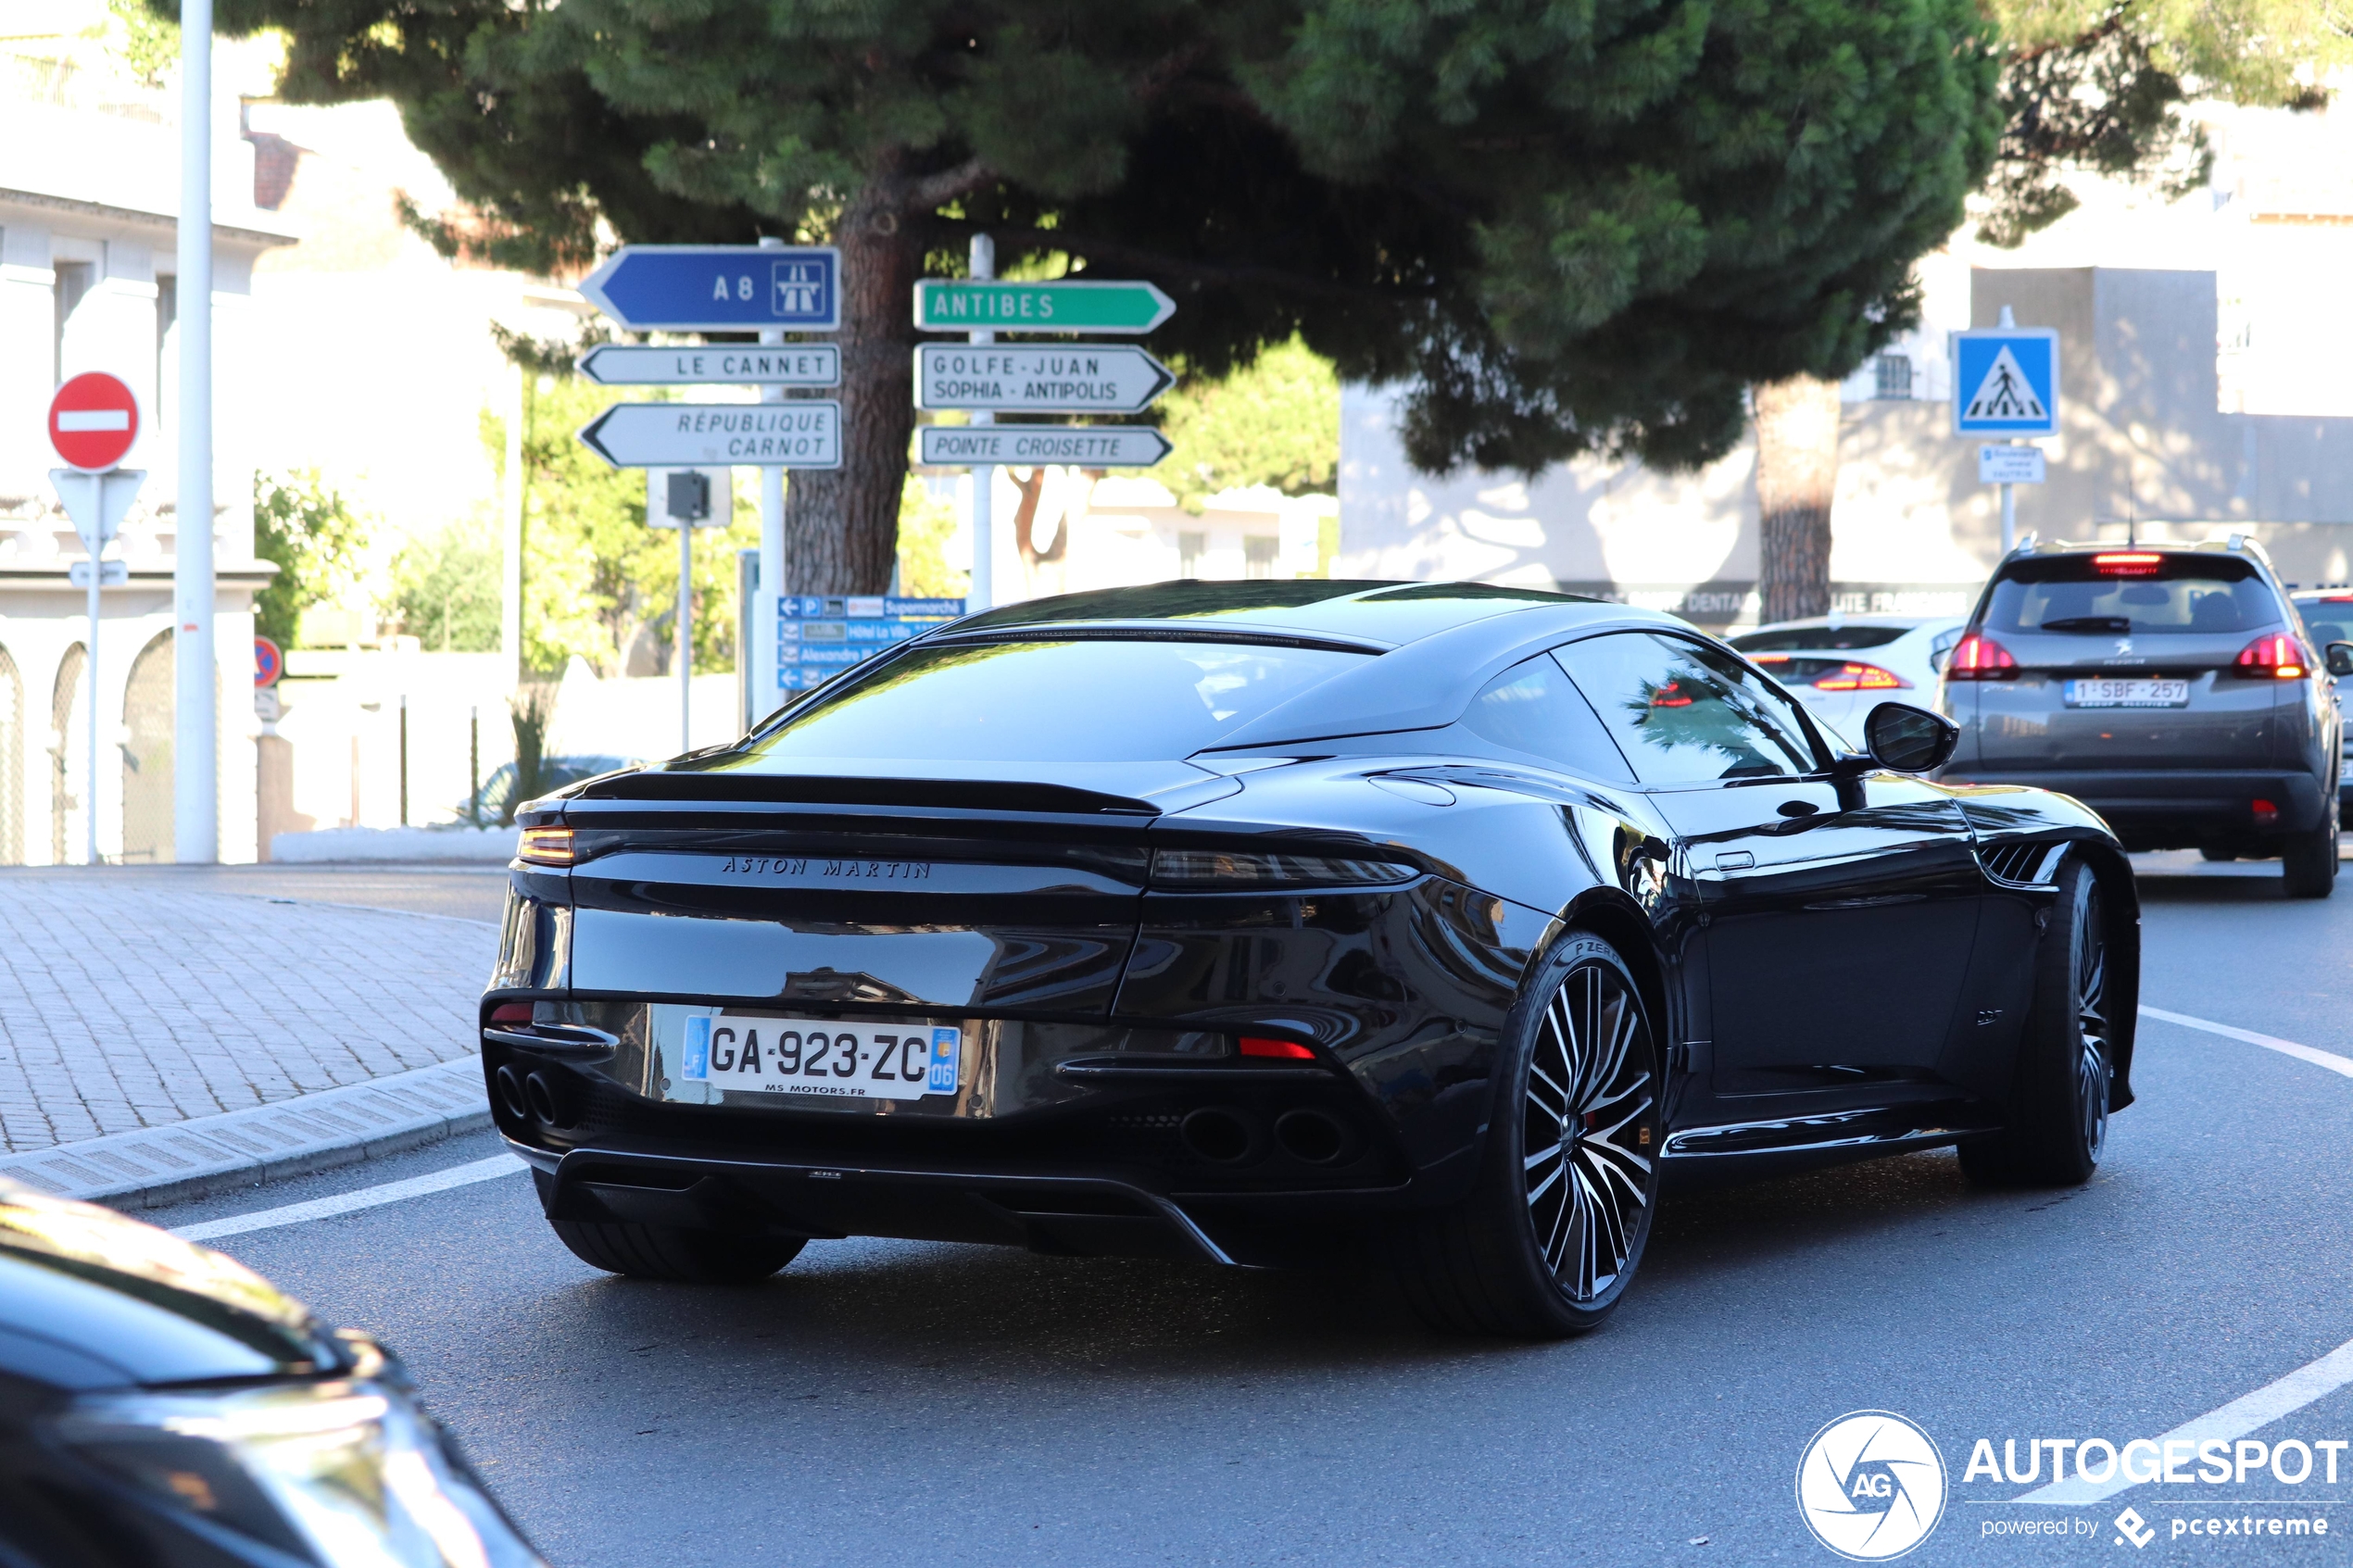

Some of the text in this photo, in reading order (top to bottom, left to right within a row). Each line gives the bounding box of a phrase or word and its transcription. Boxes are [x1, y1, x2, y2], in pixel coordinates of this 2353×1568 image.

[713, 275, 753, 301] A 8
[934, 293, 1054, 318] ANTIBES
[677, 356, 825, 375] LE CANNET
[934, 381, 1002, 399] SOPHIA
[1024, 381, 1117, 400] ANTIPOLIS
[677, 410, 825, 433] RÉPUBLIQUE
[728, 437, 825, 457] CARNOT
[935, 437, 1121, 456] POINTE CROISETTE
[886, 599, 960, 616] Supermarché
[849, 623, 875, 637] Hôtel
[801, 647, 861, 662] Alexandre
[723, 857, 931, 879] ASTON MARTIN
[1576, 943, 1583, 955] P
[711, 1027, 927, 1082] GA-923-ZC
[931, 1063, 953, 1085] 06
[765, 1084, 866, 1097] MS MOTORS.FR
